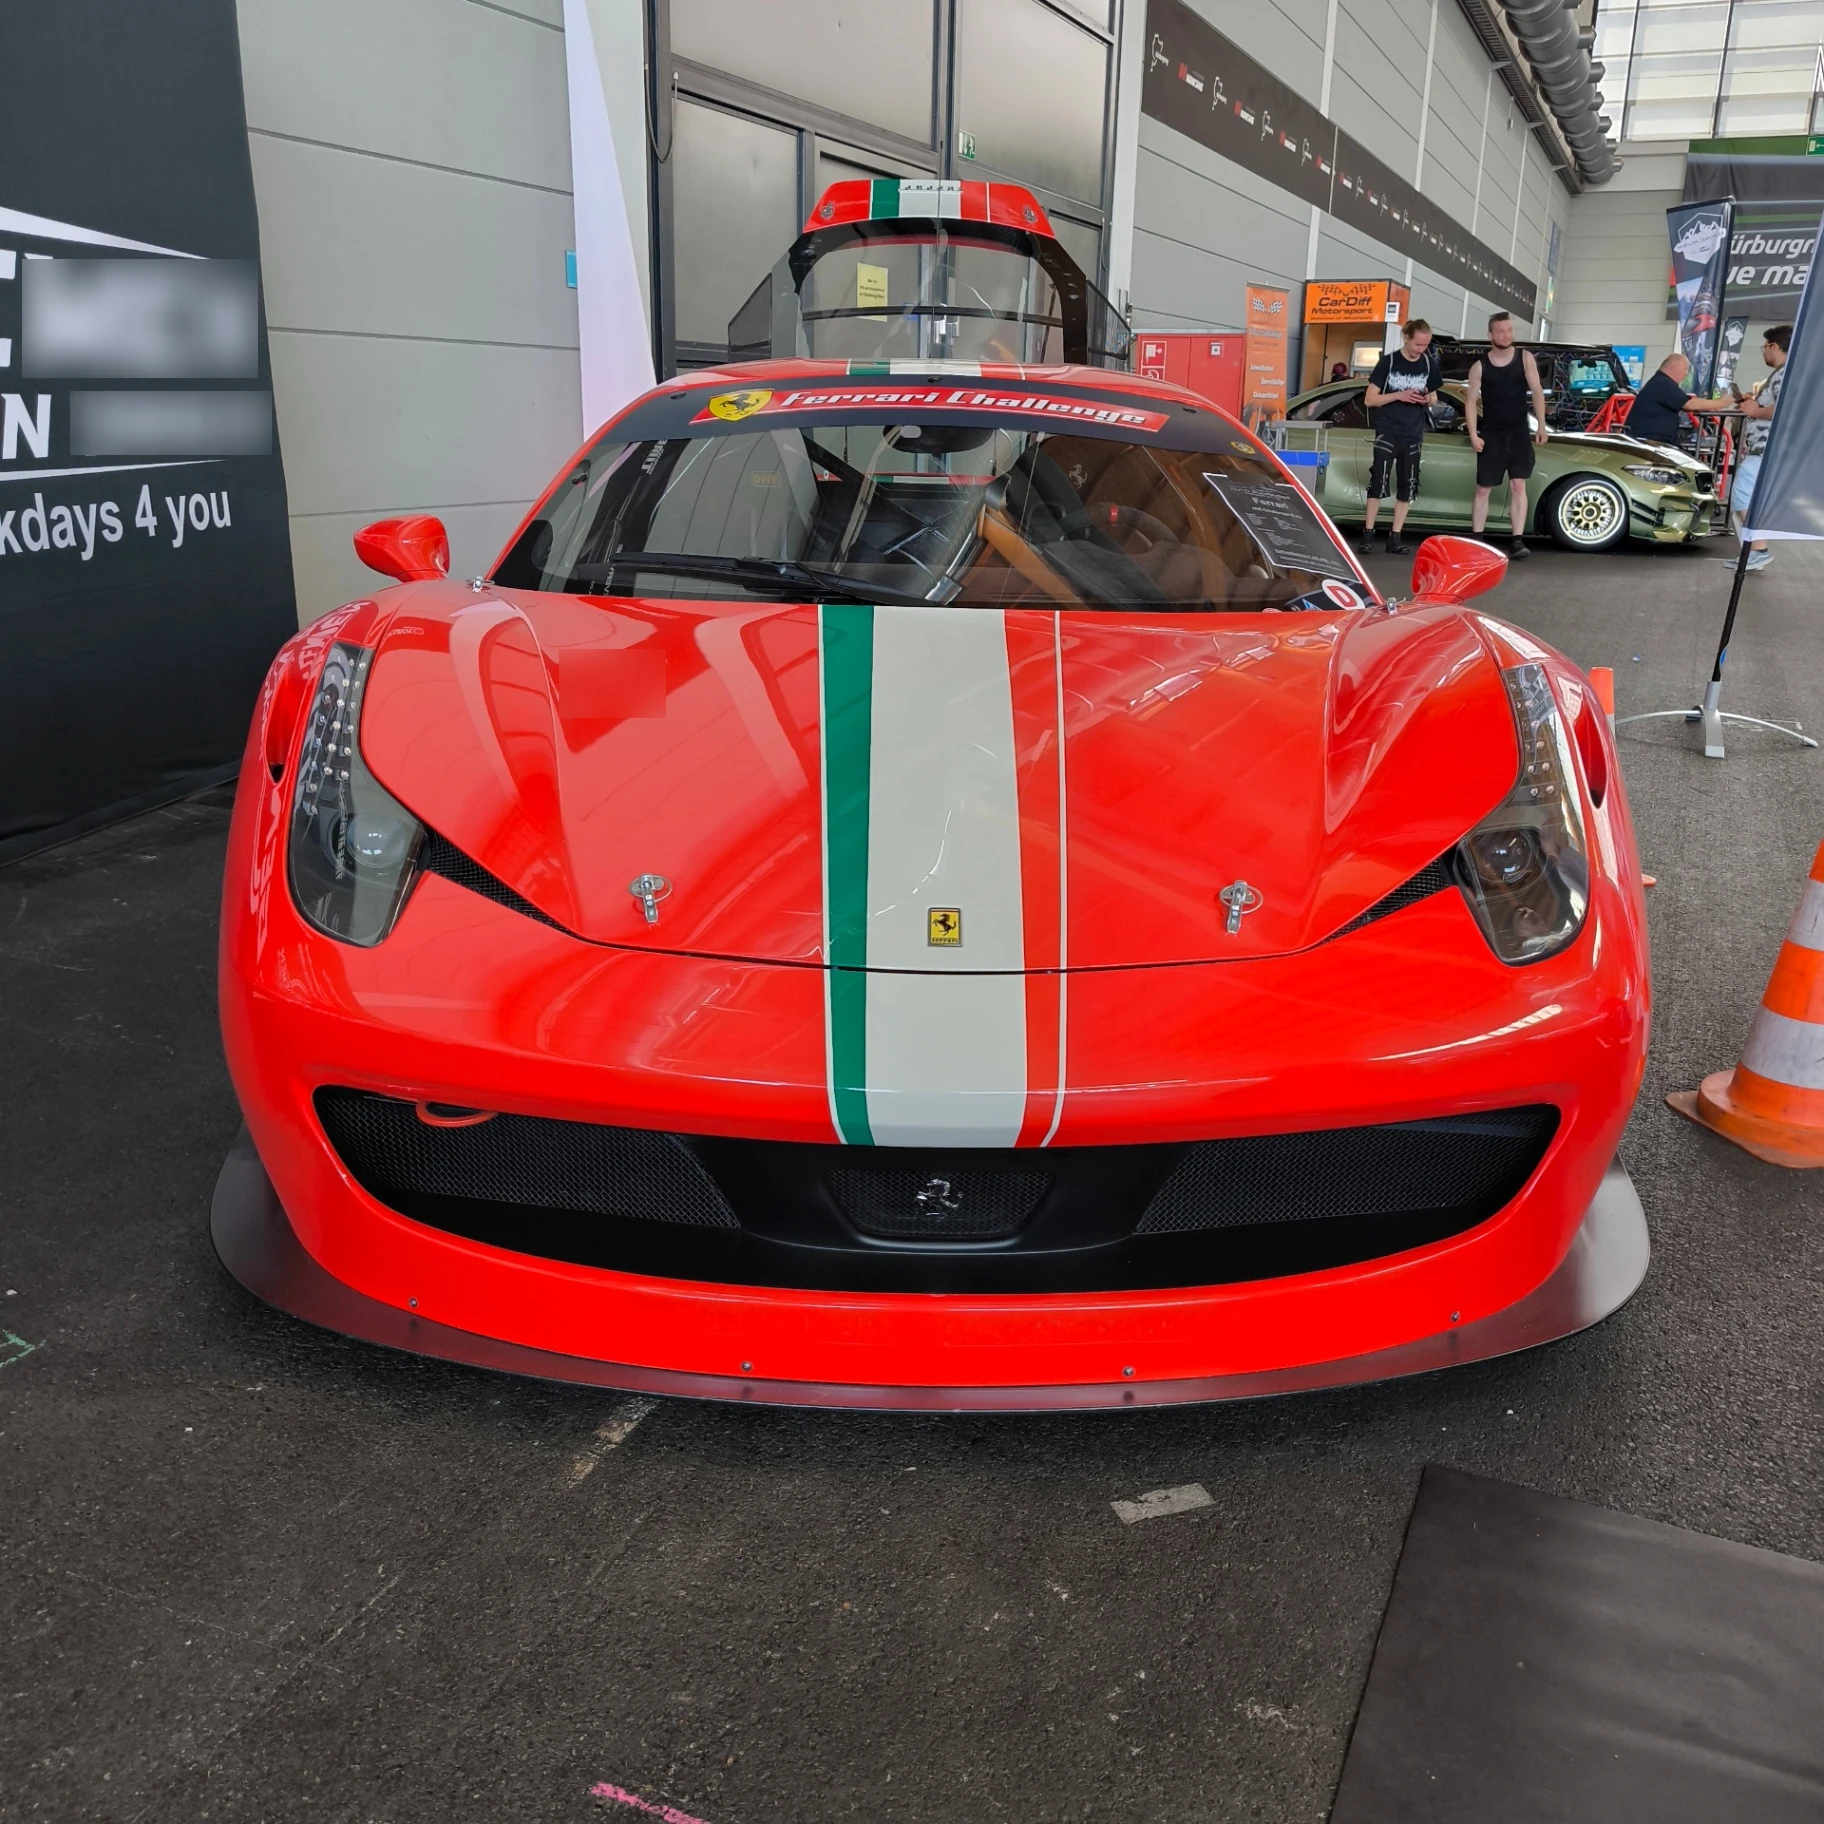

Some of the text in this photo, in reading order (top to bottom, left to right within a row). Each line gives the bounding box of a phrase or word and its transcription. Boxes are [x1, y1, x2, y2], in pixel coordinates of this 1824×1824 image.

[1730, 234, 1816, 259] ürburgr
[1318, 296, 1372, 307] CarDiff
[1311, 307, 1372, 316] Motorsport
[780, 391, 1146, 424] Ferrari Challenge
[1251, 497, 1289, 510] Ferrari
[135, 484, 158, 537] 4
[164, 491, 232, 548] you
